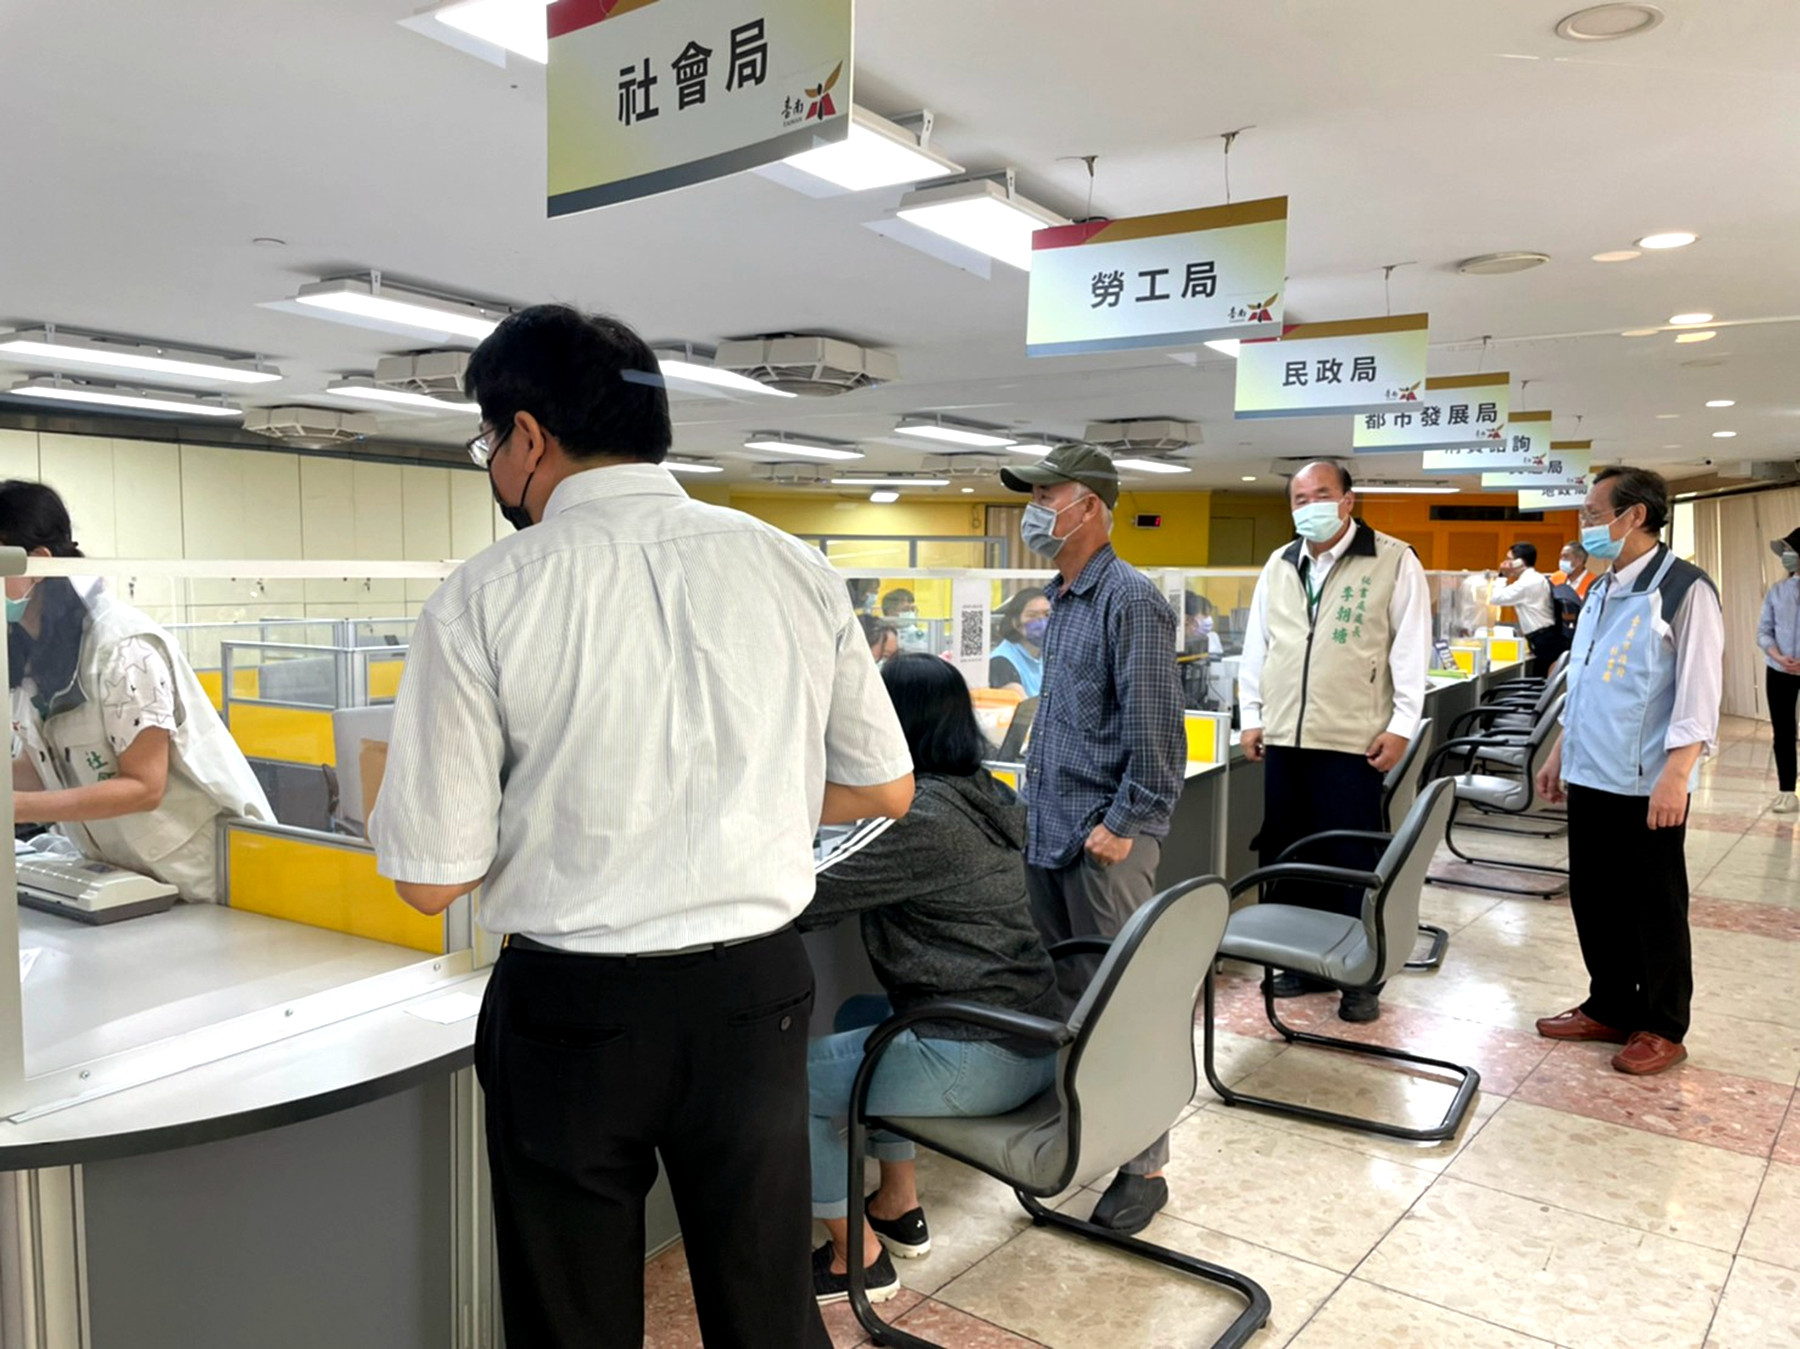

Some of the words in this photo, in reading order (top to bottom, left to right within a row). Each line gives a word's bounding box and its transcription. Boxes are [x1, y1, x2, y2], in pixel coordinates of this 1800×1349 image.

[618, 17, 768, 126] 社會局
[1090, 260, 1218, 309] 勞工局
[1282, 355, 1377, 388] 民政局
[1365, 402, 1498, 430] 都市發展局
